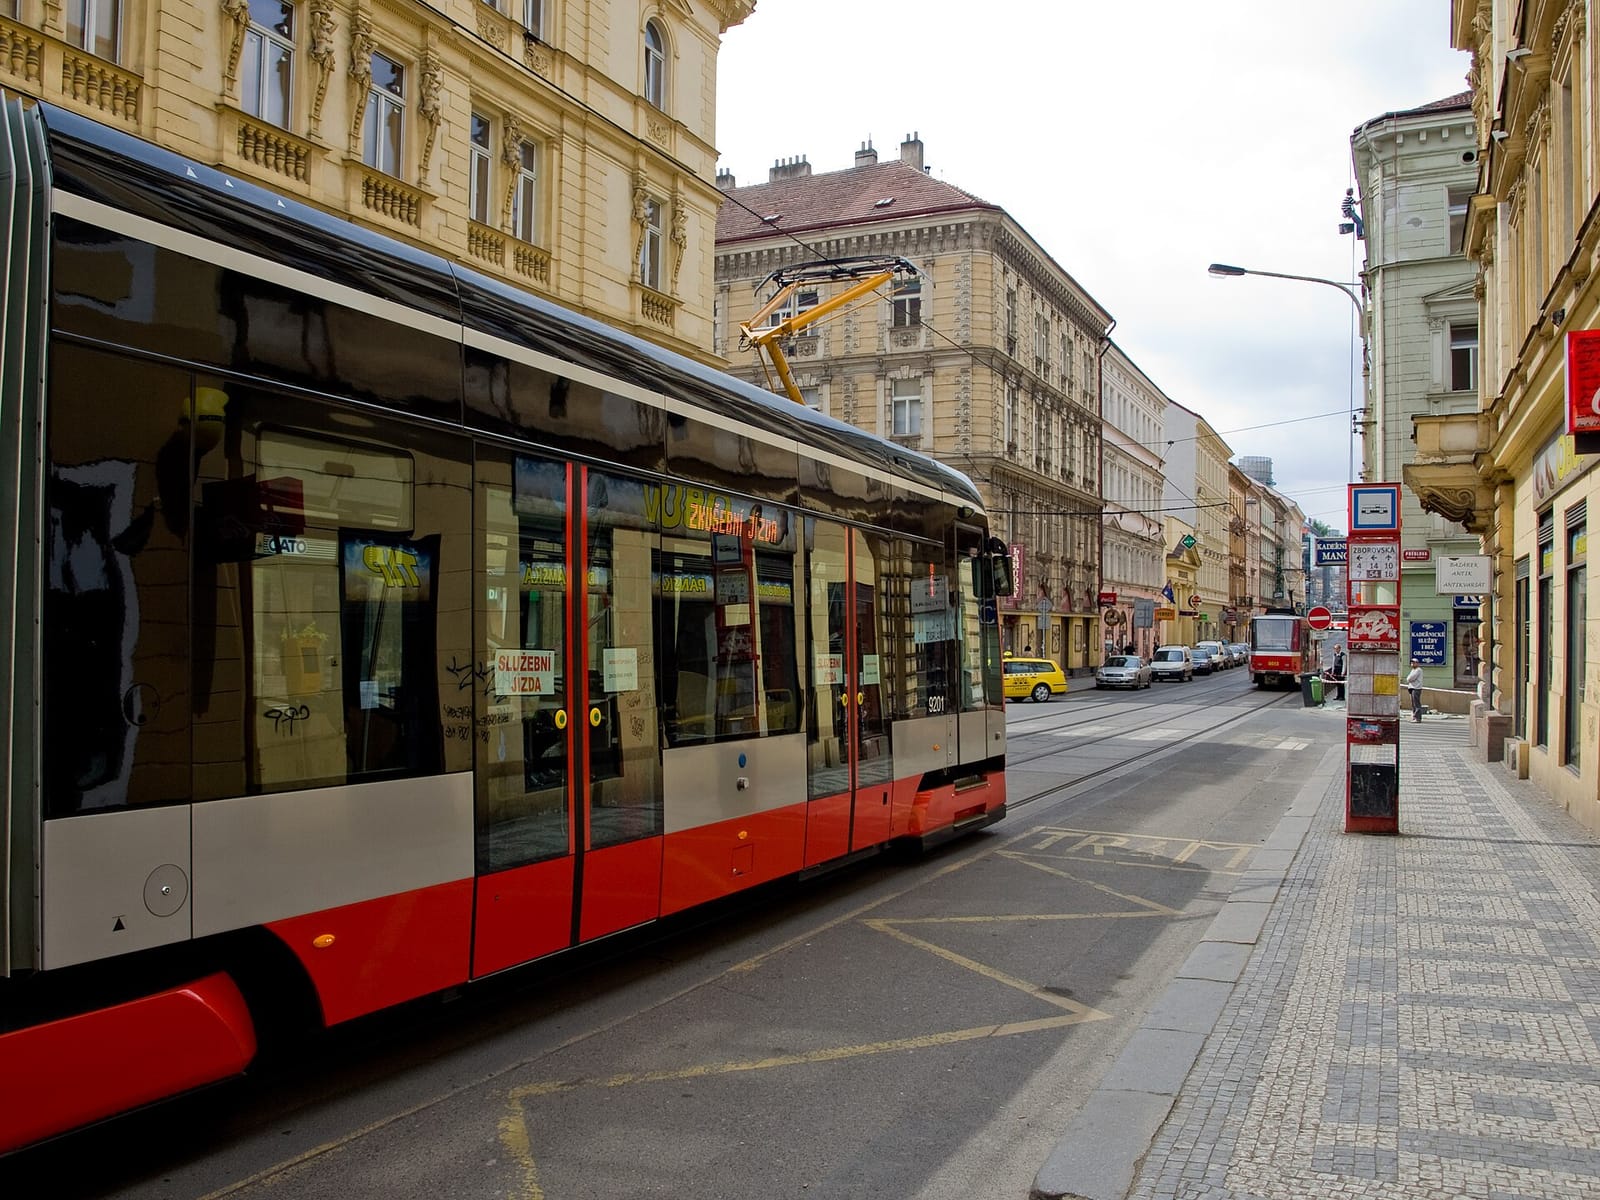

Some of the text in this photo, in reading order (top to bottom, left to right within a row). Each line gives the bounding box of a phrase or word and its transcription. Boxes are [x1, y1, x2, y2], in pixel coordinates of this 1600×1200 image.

[689, 502, 777, 543] ZKUŠEBNÍ JÍZDA
[1353, 546, 1395, 554] ZBOROVSKÁ
[1356, 570, 1361, 578] 7
[1384, 570, 1393, 578] 16
[498, 652, 551, 673] SLUŽEBNÍ
[511, 674, 542, 693] JÍZDA
[928, 695, 945, 713] 9201
